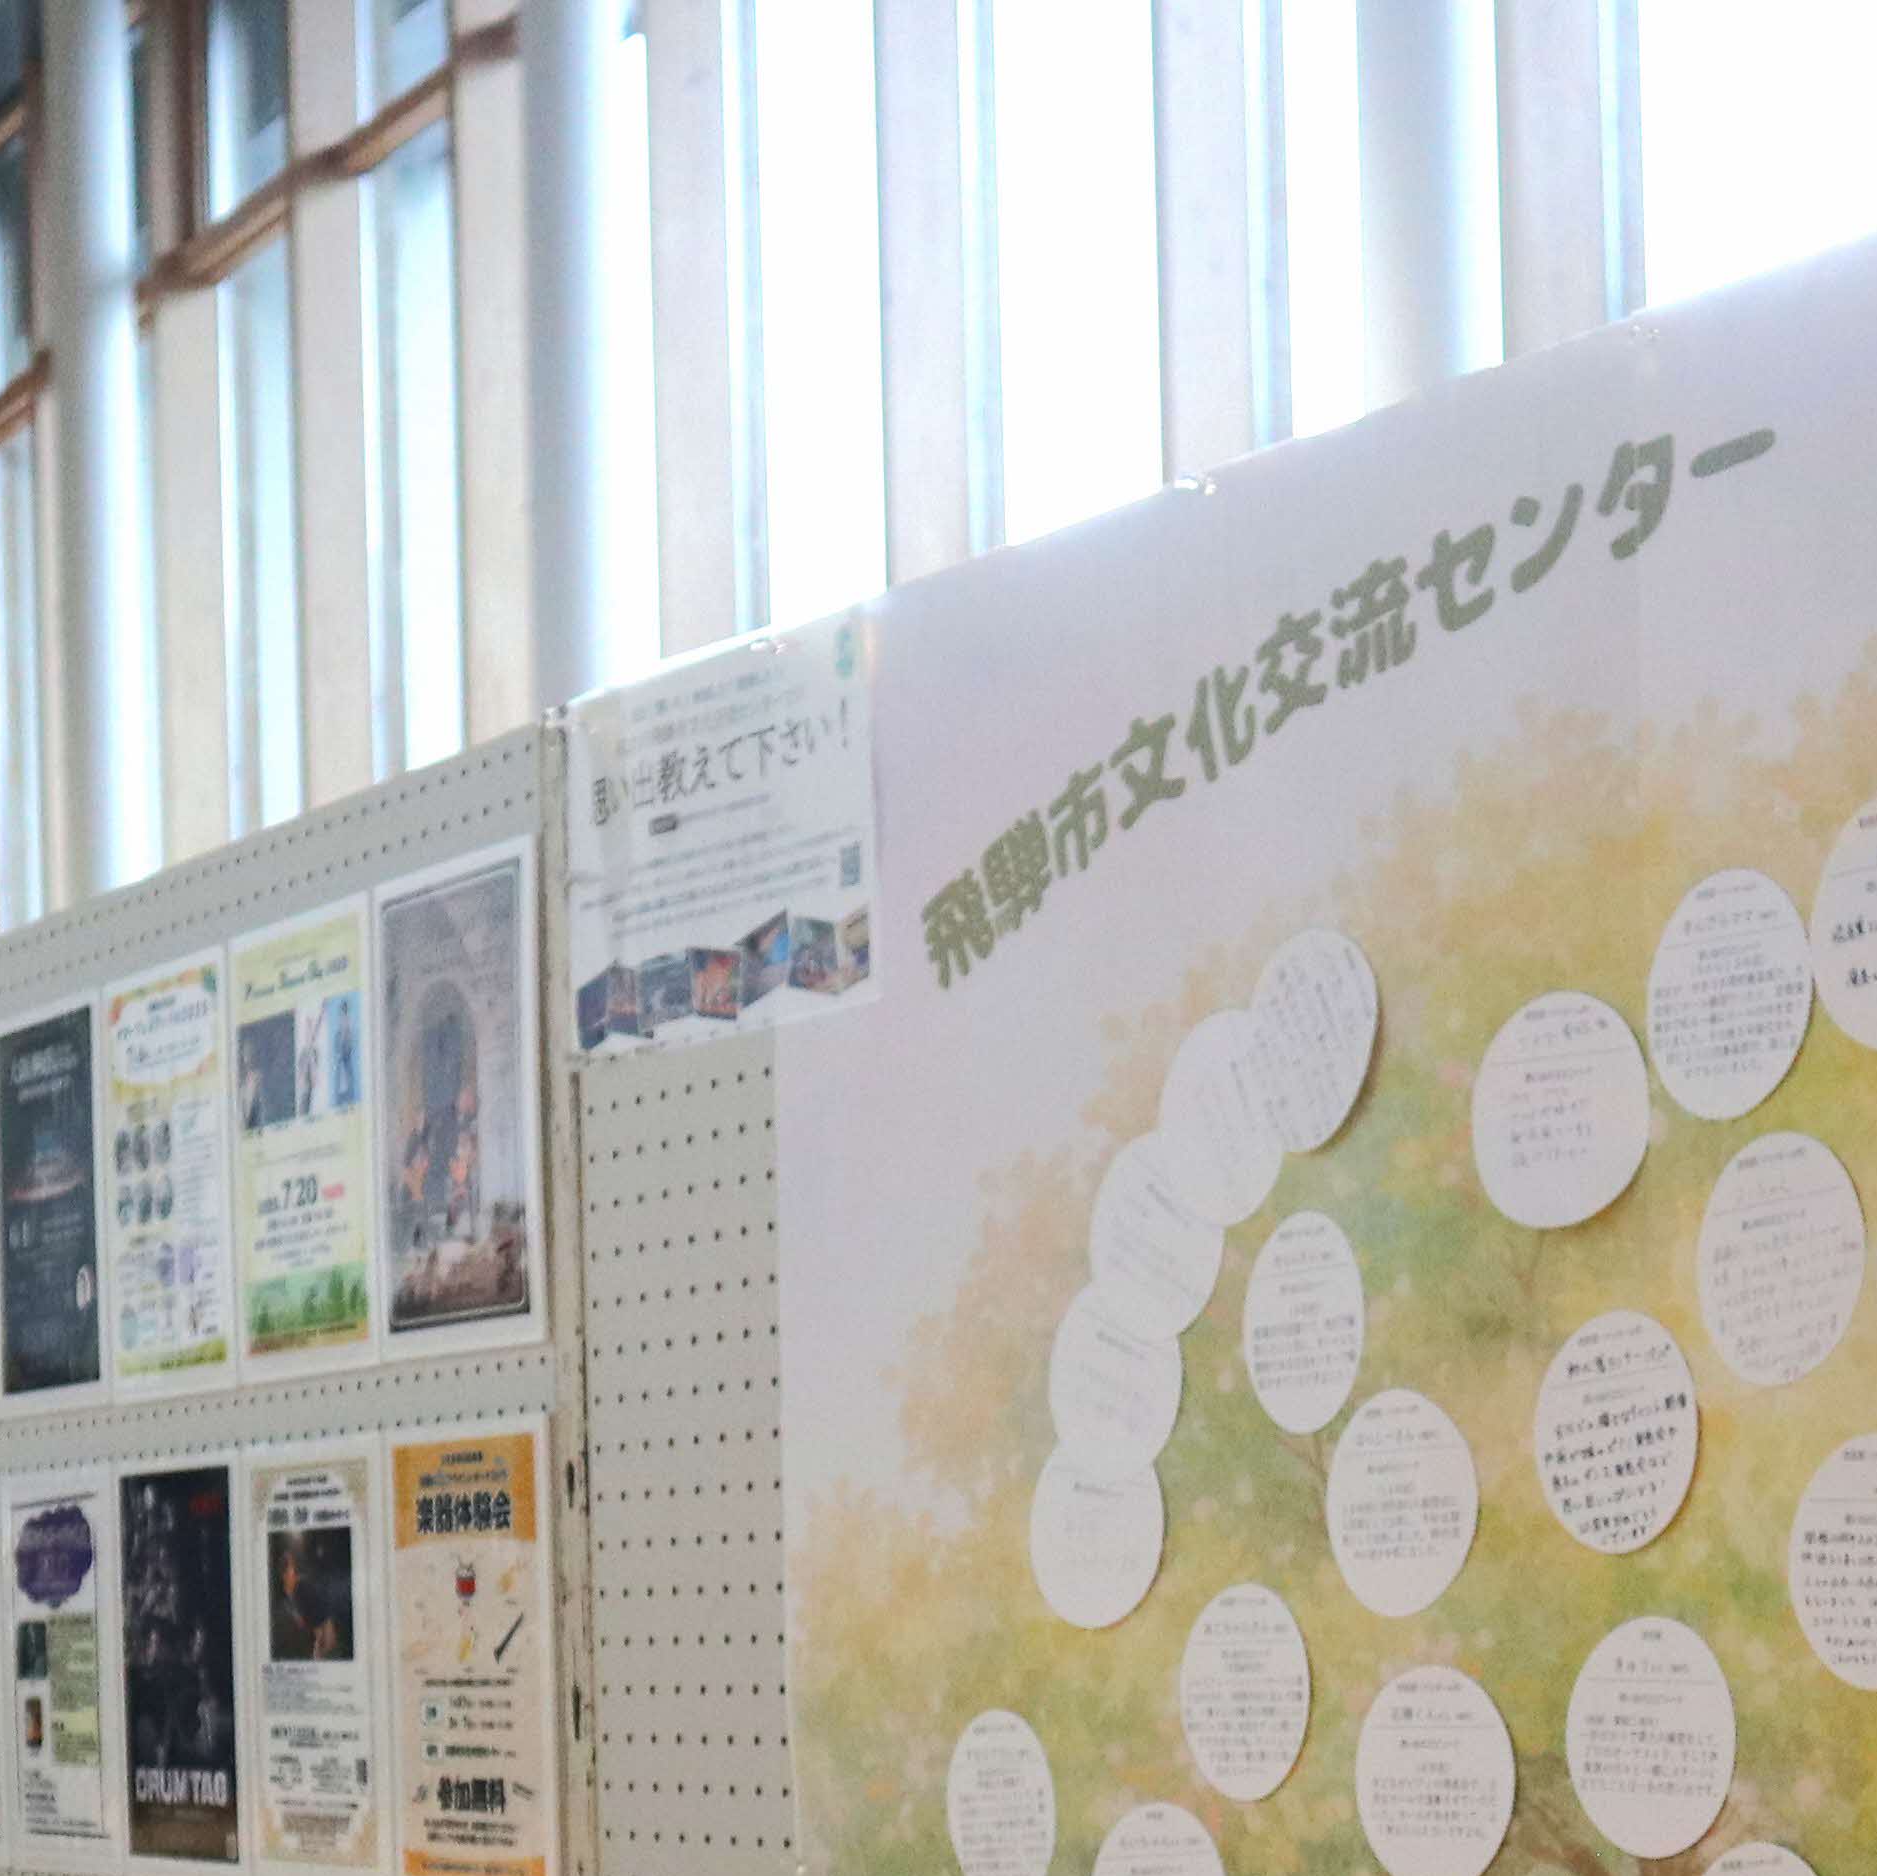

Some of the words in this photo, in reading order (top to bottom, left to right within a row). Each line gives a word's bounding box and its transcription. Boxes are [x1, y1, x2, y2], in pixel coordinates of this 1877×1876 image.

[922, 427, 1776, 989] 飛騨市文化交流センター
